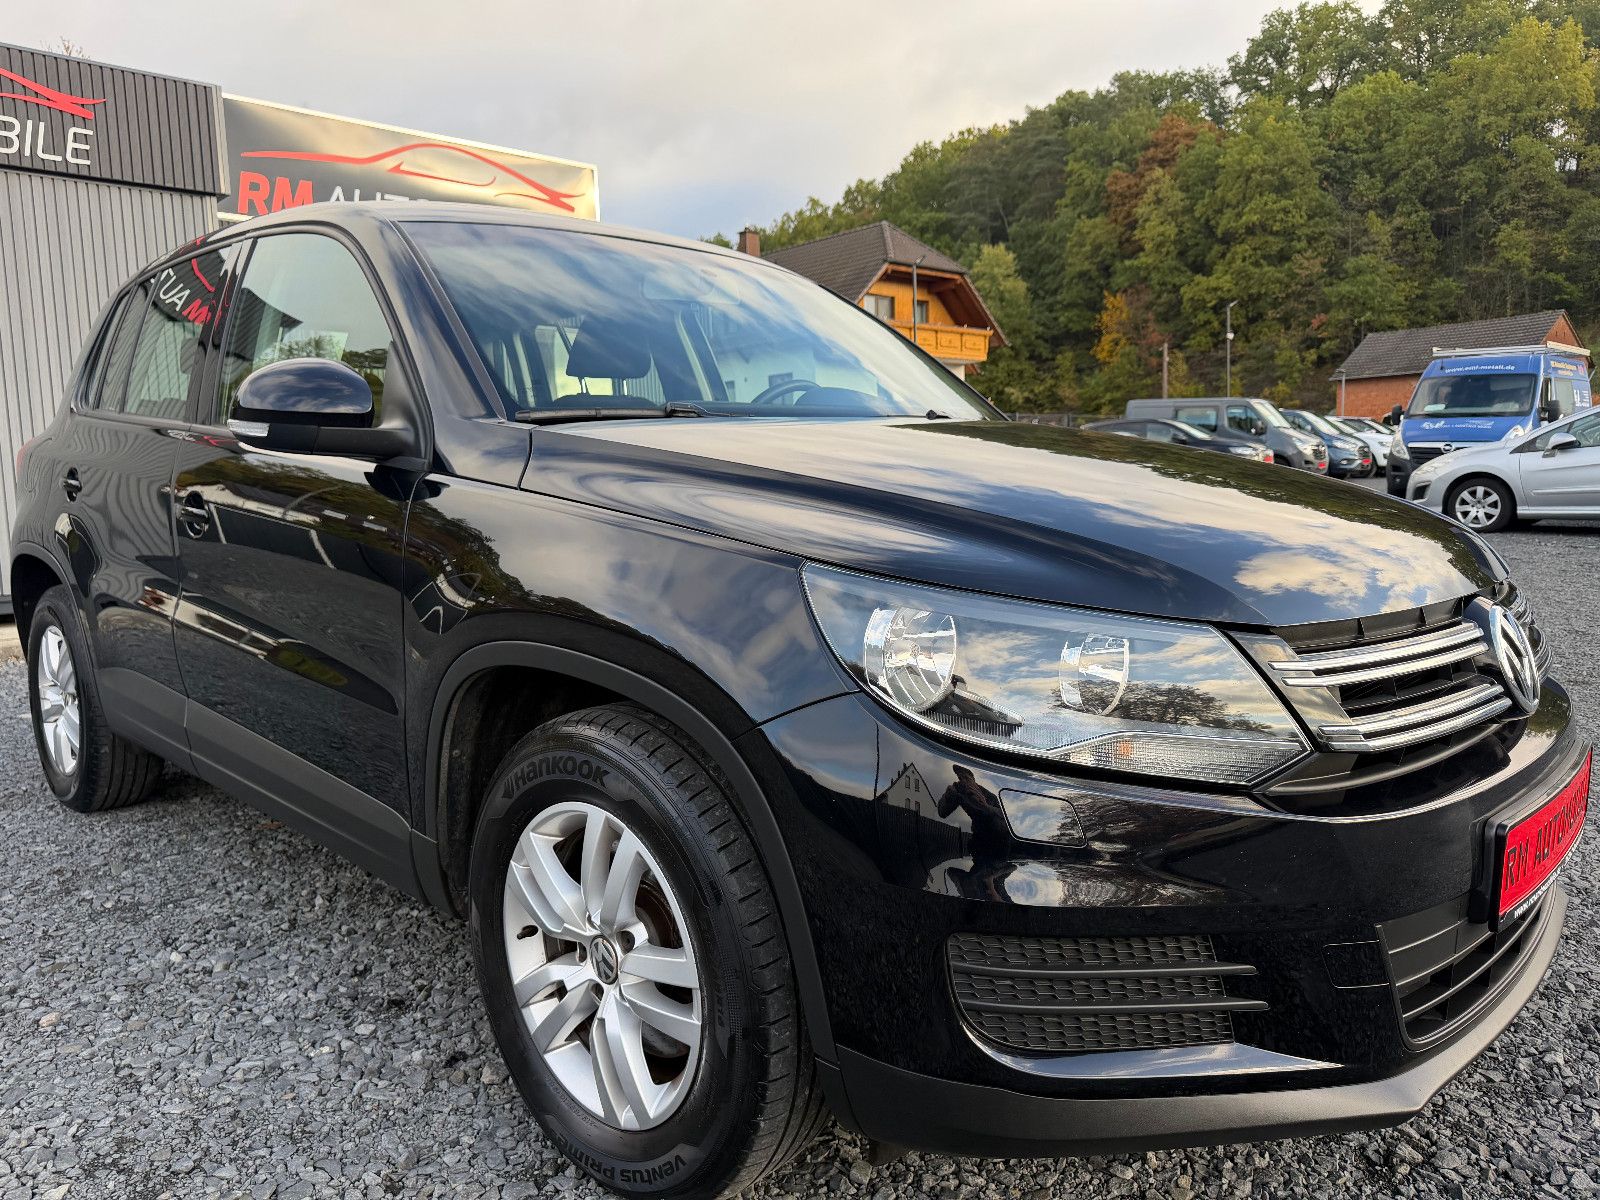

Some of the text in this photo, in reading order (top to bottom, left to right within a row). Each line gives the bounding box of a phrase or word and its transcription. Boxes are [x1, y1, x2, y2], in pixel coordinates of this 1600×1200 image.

[0, 115, 94, 165] BILE
[237, 170, 314, 216] RM
[1504, 836, 1529, 893] RM
